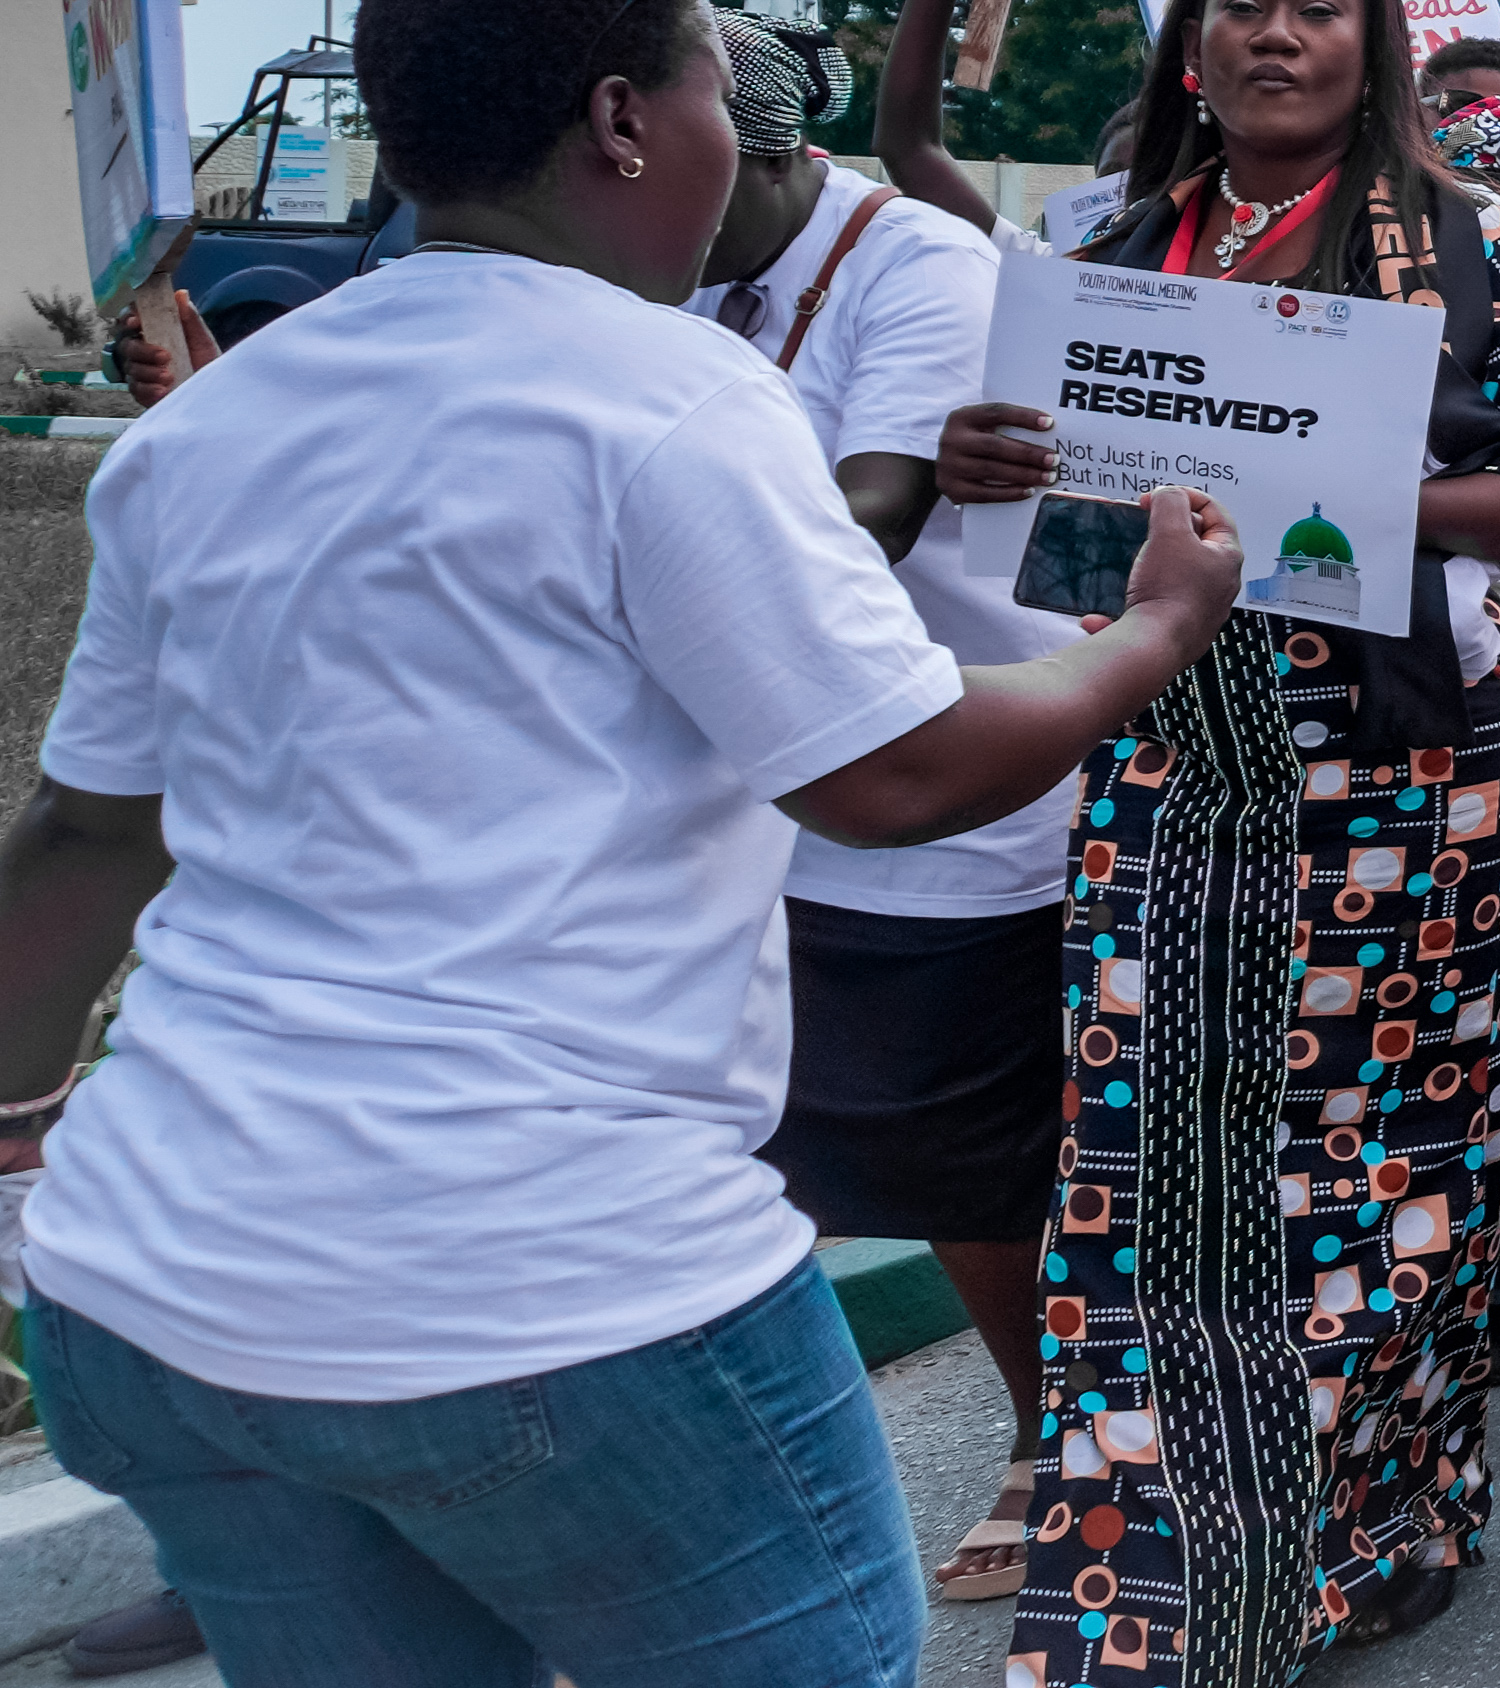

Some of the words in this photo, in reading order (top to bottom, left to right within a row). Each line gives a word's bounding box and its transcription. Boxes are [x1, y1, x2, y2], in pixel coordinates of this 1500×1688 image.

[1078, 272, 1105, 290] YOUTH
[1107, 276, 1134, 293] TOWN
[1135, 279, 1156, 297] HALL
[1158, 283, 1197, 301] MEETING
[1064, 341, 1205, 385] SEATS
[1058, 378, 1319, 439] RESERVED?
[1055, 438, 1094, 461] Not
[1100, 445, 1145, 469] Just
[1151, 450, 1168, 472] in
[1175, 454, 1239, 485] Class,
[1057, 463, 1092, 485] But
[1098, 467, 1115, 489] in
